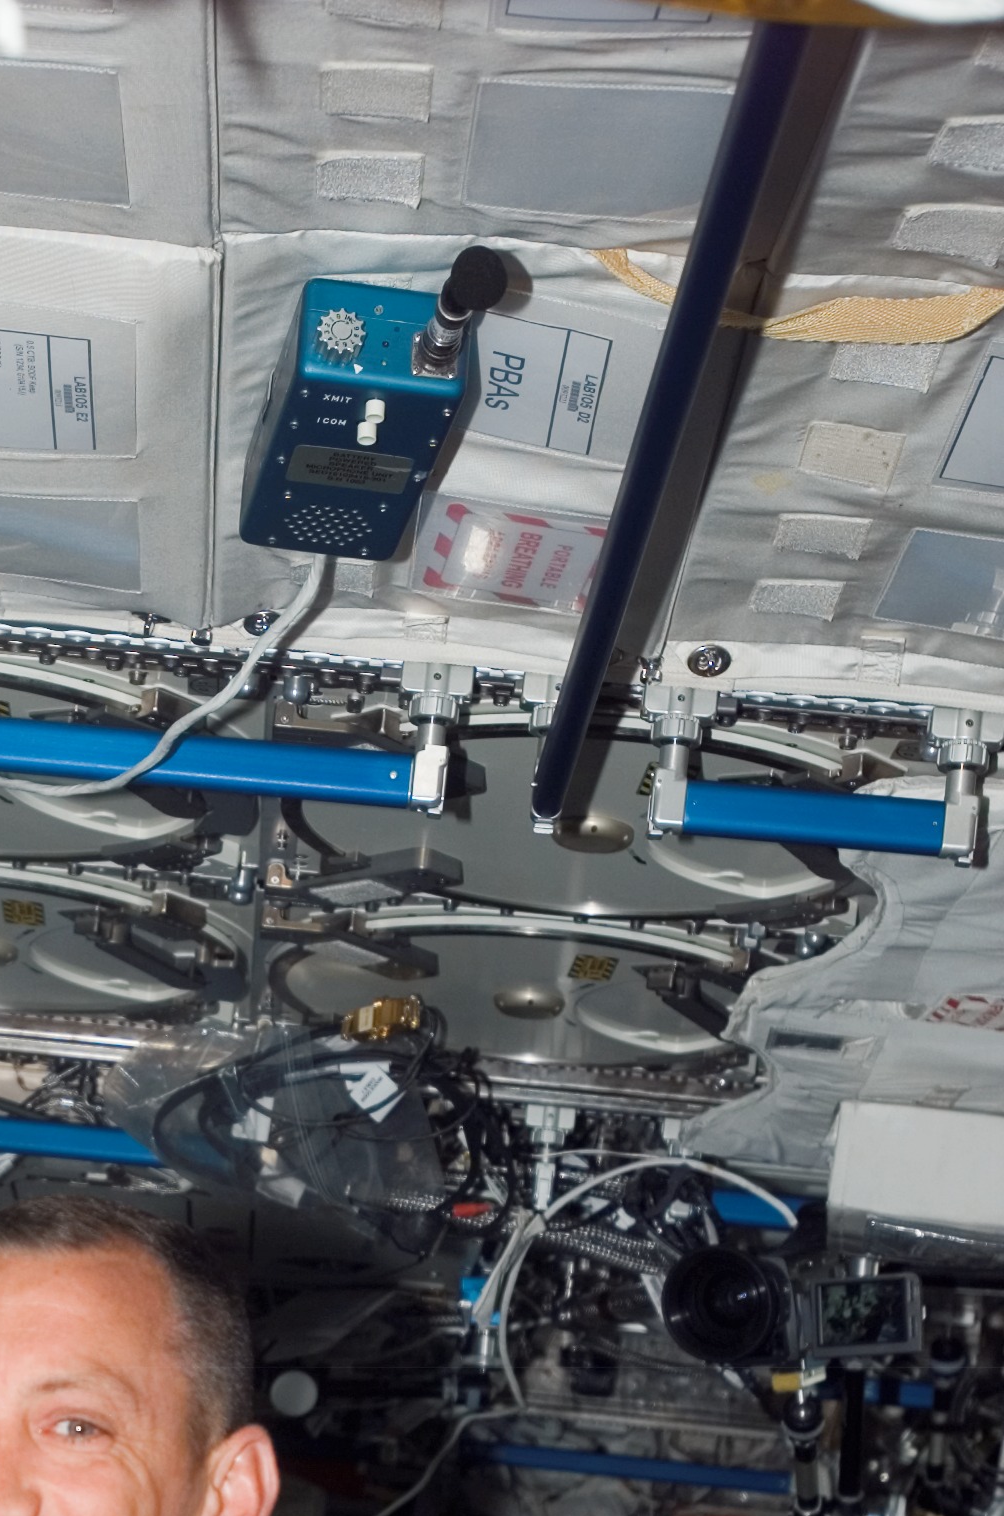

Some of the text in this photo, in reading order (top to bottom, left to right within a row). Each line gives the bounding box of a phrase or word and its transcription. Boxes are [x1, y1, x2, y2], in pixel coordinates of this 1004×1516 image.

[485, 351, 526, 411] PBAs
[323, 393, 353, 404] XMIT
[317, 417, 347, 426] ICOM
[576, 411, 591, 424] D2
[329, 456, 376, 466] POWERED
[333, 452, 375, 461] BATTERY
[306, 463, 393, 479] MICROPHONE UNIT
[501, 532, 543, 589] BREATHING
[540, 544, 574, 589] PORTABLE
